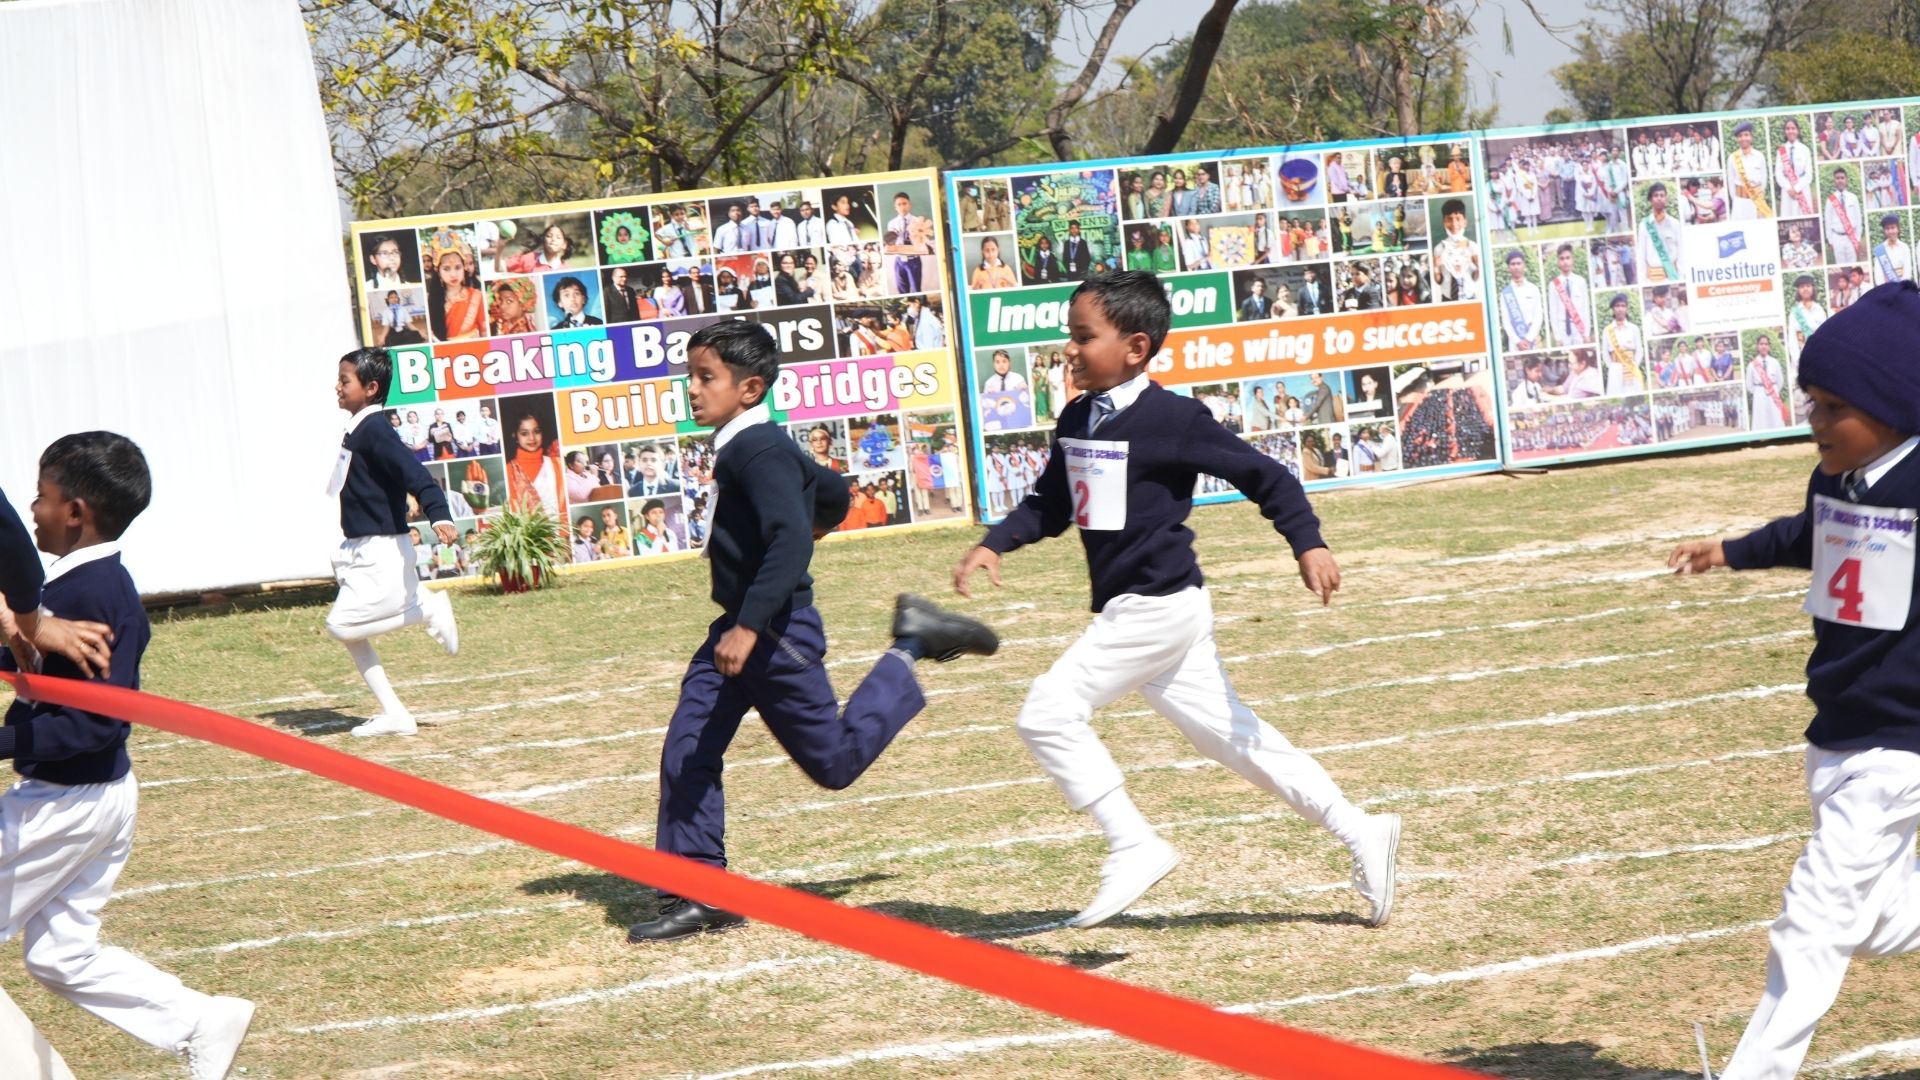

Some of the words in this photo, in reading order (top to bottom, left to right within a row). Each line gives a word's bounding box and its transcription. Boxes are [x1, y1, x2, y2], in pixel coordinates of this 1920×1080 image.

[1691, 262, 1775, 283] Investiture
[1708, 284, 1761, 297] Ceremony
[397, 335, 616, 394] Breaking
[1182, 336, 1234, 370] the
[1243, 329, 1314, 364] wing
[1323, 326, 1355, 355] to
[1363, 317, 1476, 351] success.
[569, 380, 695, 433] Build
[772, 362, 939, 412] Bridges
[1075, 480, 1090, 528] 2
[1828, 558, 1864, 622] 4
